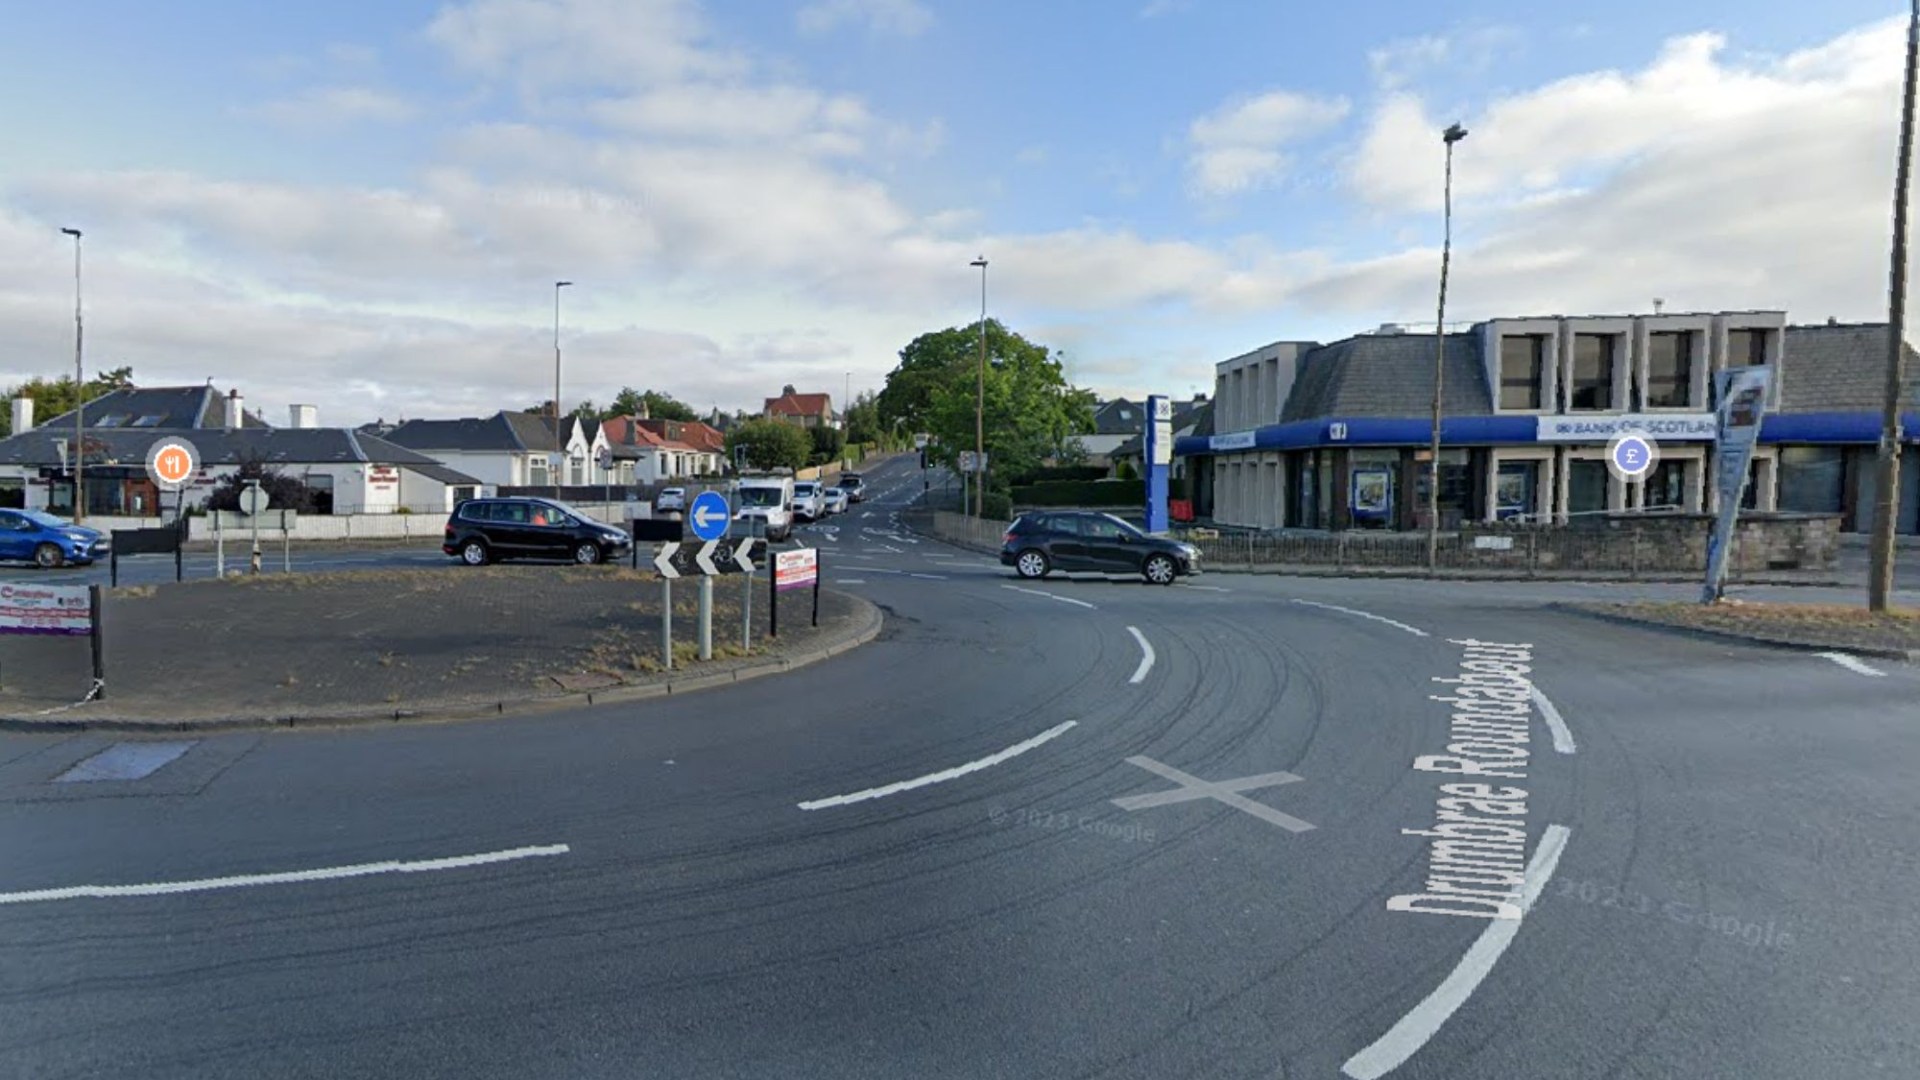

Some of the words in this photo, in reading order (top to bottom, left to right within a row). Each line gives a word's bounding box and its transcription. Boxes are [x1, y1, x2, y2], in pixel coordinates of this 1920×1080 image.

[1574, 421, 1615, 434] BANK
[1620, 420, 1642, 433] OF
[1647, 420, 1715, 433] SCOTLAN
